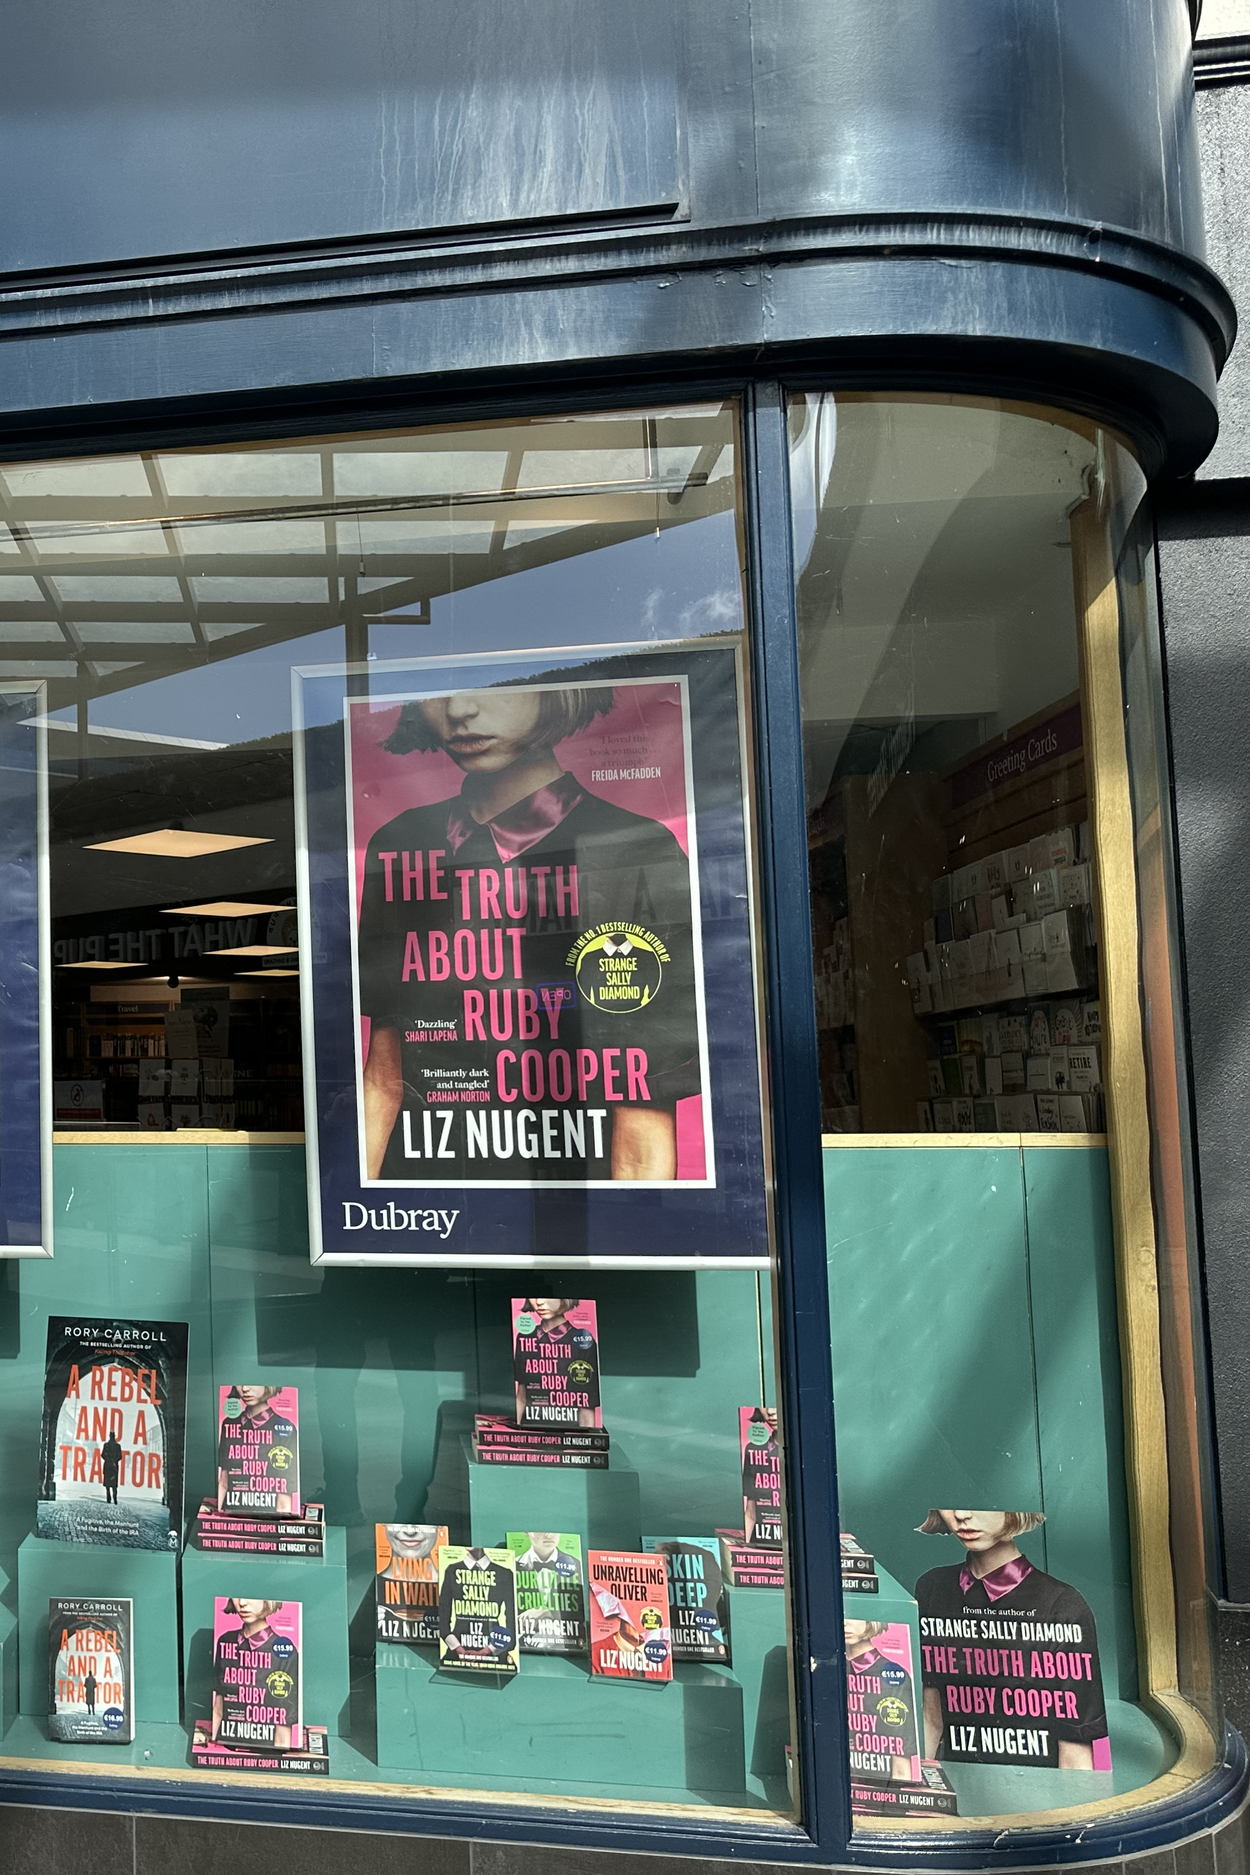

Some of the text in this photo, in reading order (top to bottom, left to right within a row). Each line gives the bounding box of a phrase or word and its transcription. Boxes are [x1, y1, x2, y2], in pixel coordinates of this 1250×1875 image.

[987, 728, 1058, 782] Greeting Cards
[591, 769, 619, 782] FREIDA
[378, 850, 448, 902] THE
[454, 864, 579, 921] TRUTH
[401, 926, 527, 983] ABOUT
[565, 948, 579, 967] FROM
[575, 936, 588, 951] THE
[600, 921, 646, 937] BESTSELLING
[643, 930, 667, 956] AUTHOR
[659, 953, 672, 964] OF
[598, 957, 638, 972] STRANGE
[605, 971, 632, 986] SALLY
[599, 985, 640, 1000] DIAMOND
[116, 1005, 139, 1014] Travel
[464, 987, 563, 1042] RUBY
[404, 1030, 459, 1043] SHARI LAPENA
[468, 1068, 490, 1078] dark
[496, 1047, 651, 1103] COOPER
[436, 1080, 454, 1089] and
[426, 1090, 491, 1103] GRAHAM NORTON
[402, 1107, 608, 1161] LIZ NUGENT
[342, 1201, 460, 1240] Dubray
[64, 1326, 167, 1342] RORY CARROLL
[66, 1363, 163, 1406] A REBEL
[75, 1405, 149, 1446] AND A
[58, 1443, 163, 1490] TRATOR
[455, 1568, 497, 1587] STRANGE
[592, 1564, 665, 1586] UNRAVELLING
[462, 1585, 490, 1601] SALLY
[517, 1591, 580, 1613] CRUELTIES
[610, 1583, 648, 1602] OLIVER
[455, 1600, 499, 1617] DIAMOND
[962, 1605, 1037, 1617] from the author of
[469, 1621, 484, 1635] LIZ
[920, 1617, 1083, 1643] STRANGE SALLY DIAMOND
[921, 1644, 1094, 1682] THE TRUTH ABOUT
[946, 1684, 1080, 1720] RUBY COOPER
[949, 1725, 1050, 1757] LIZ NUGENT
